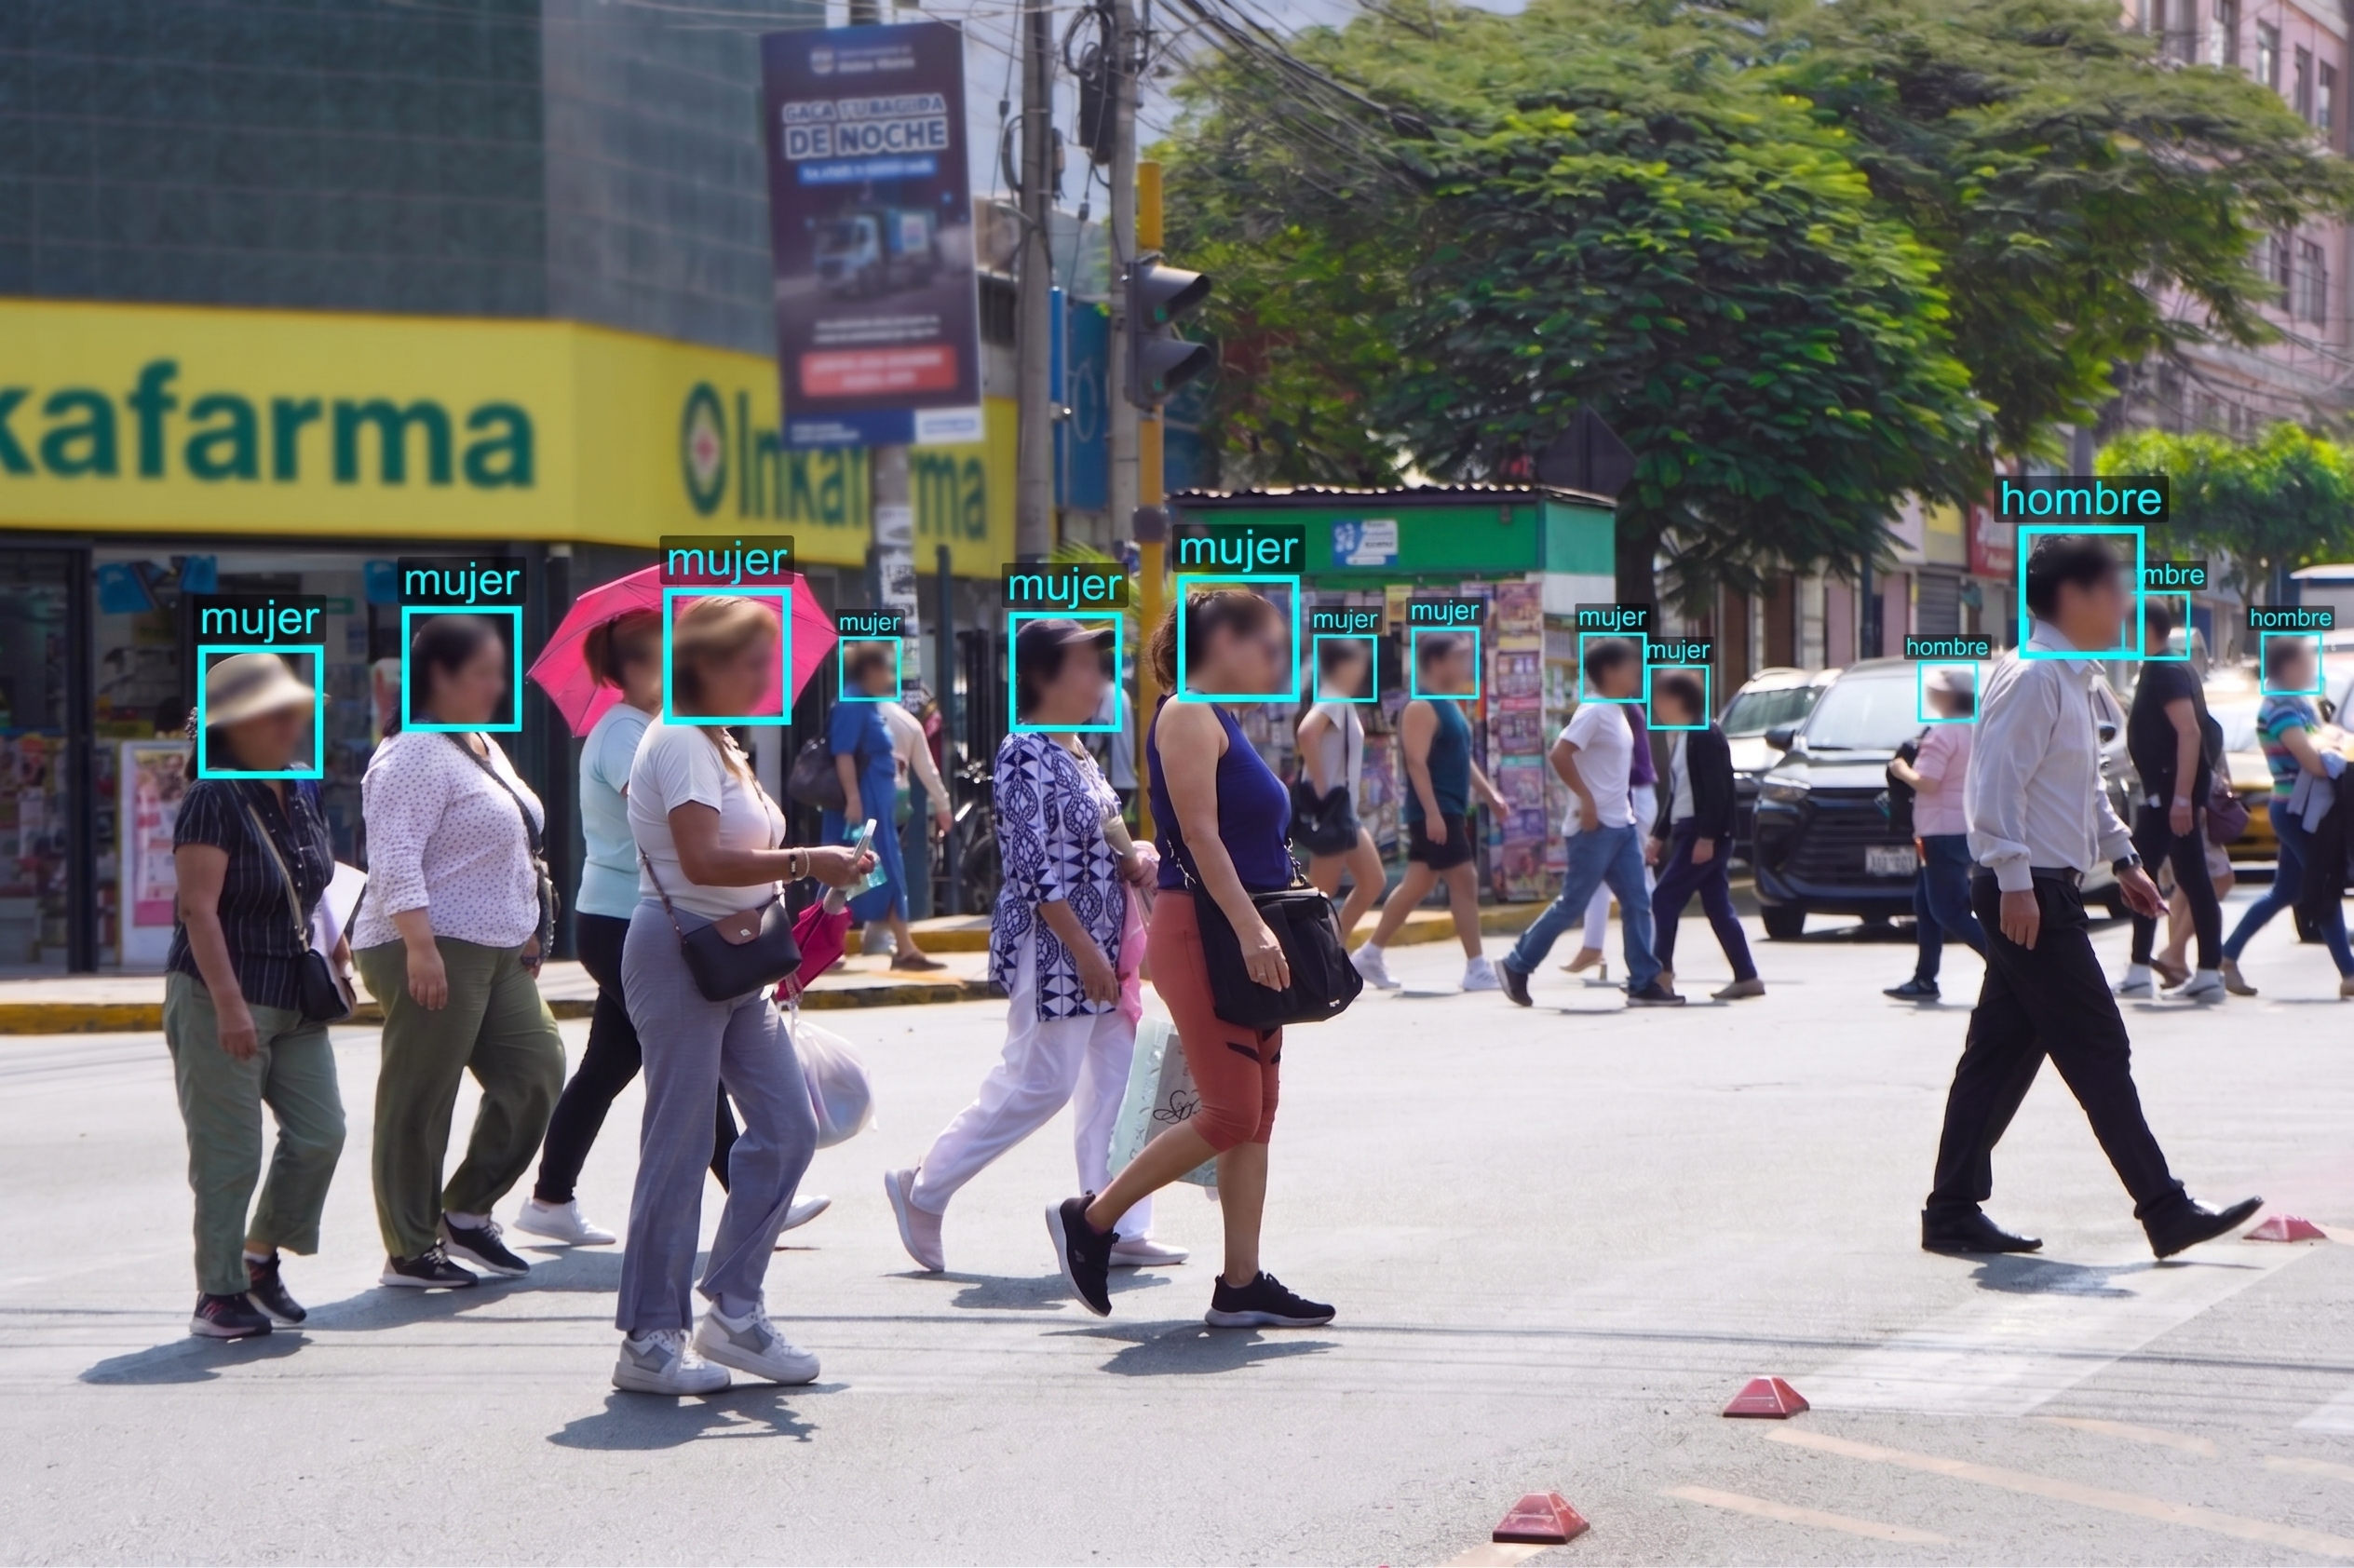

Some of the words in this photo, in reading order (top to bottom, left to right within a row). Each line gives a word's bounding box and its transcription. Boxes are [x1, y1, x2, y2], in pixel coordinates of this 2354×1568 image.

[788, 126, 830, 157] DE
[839, 119, 946, 153] NOCHE
[737, 389, 987, 540] Inkama
